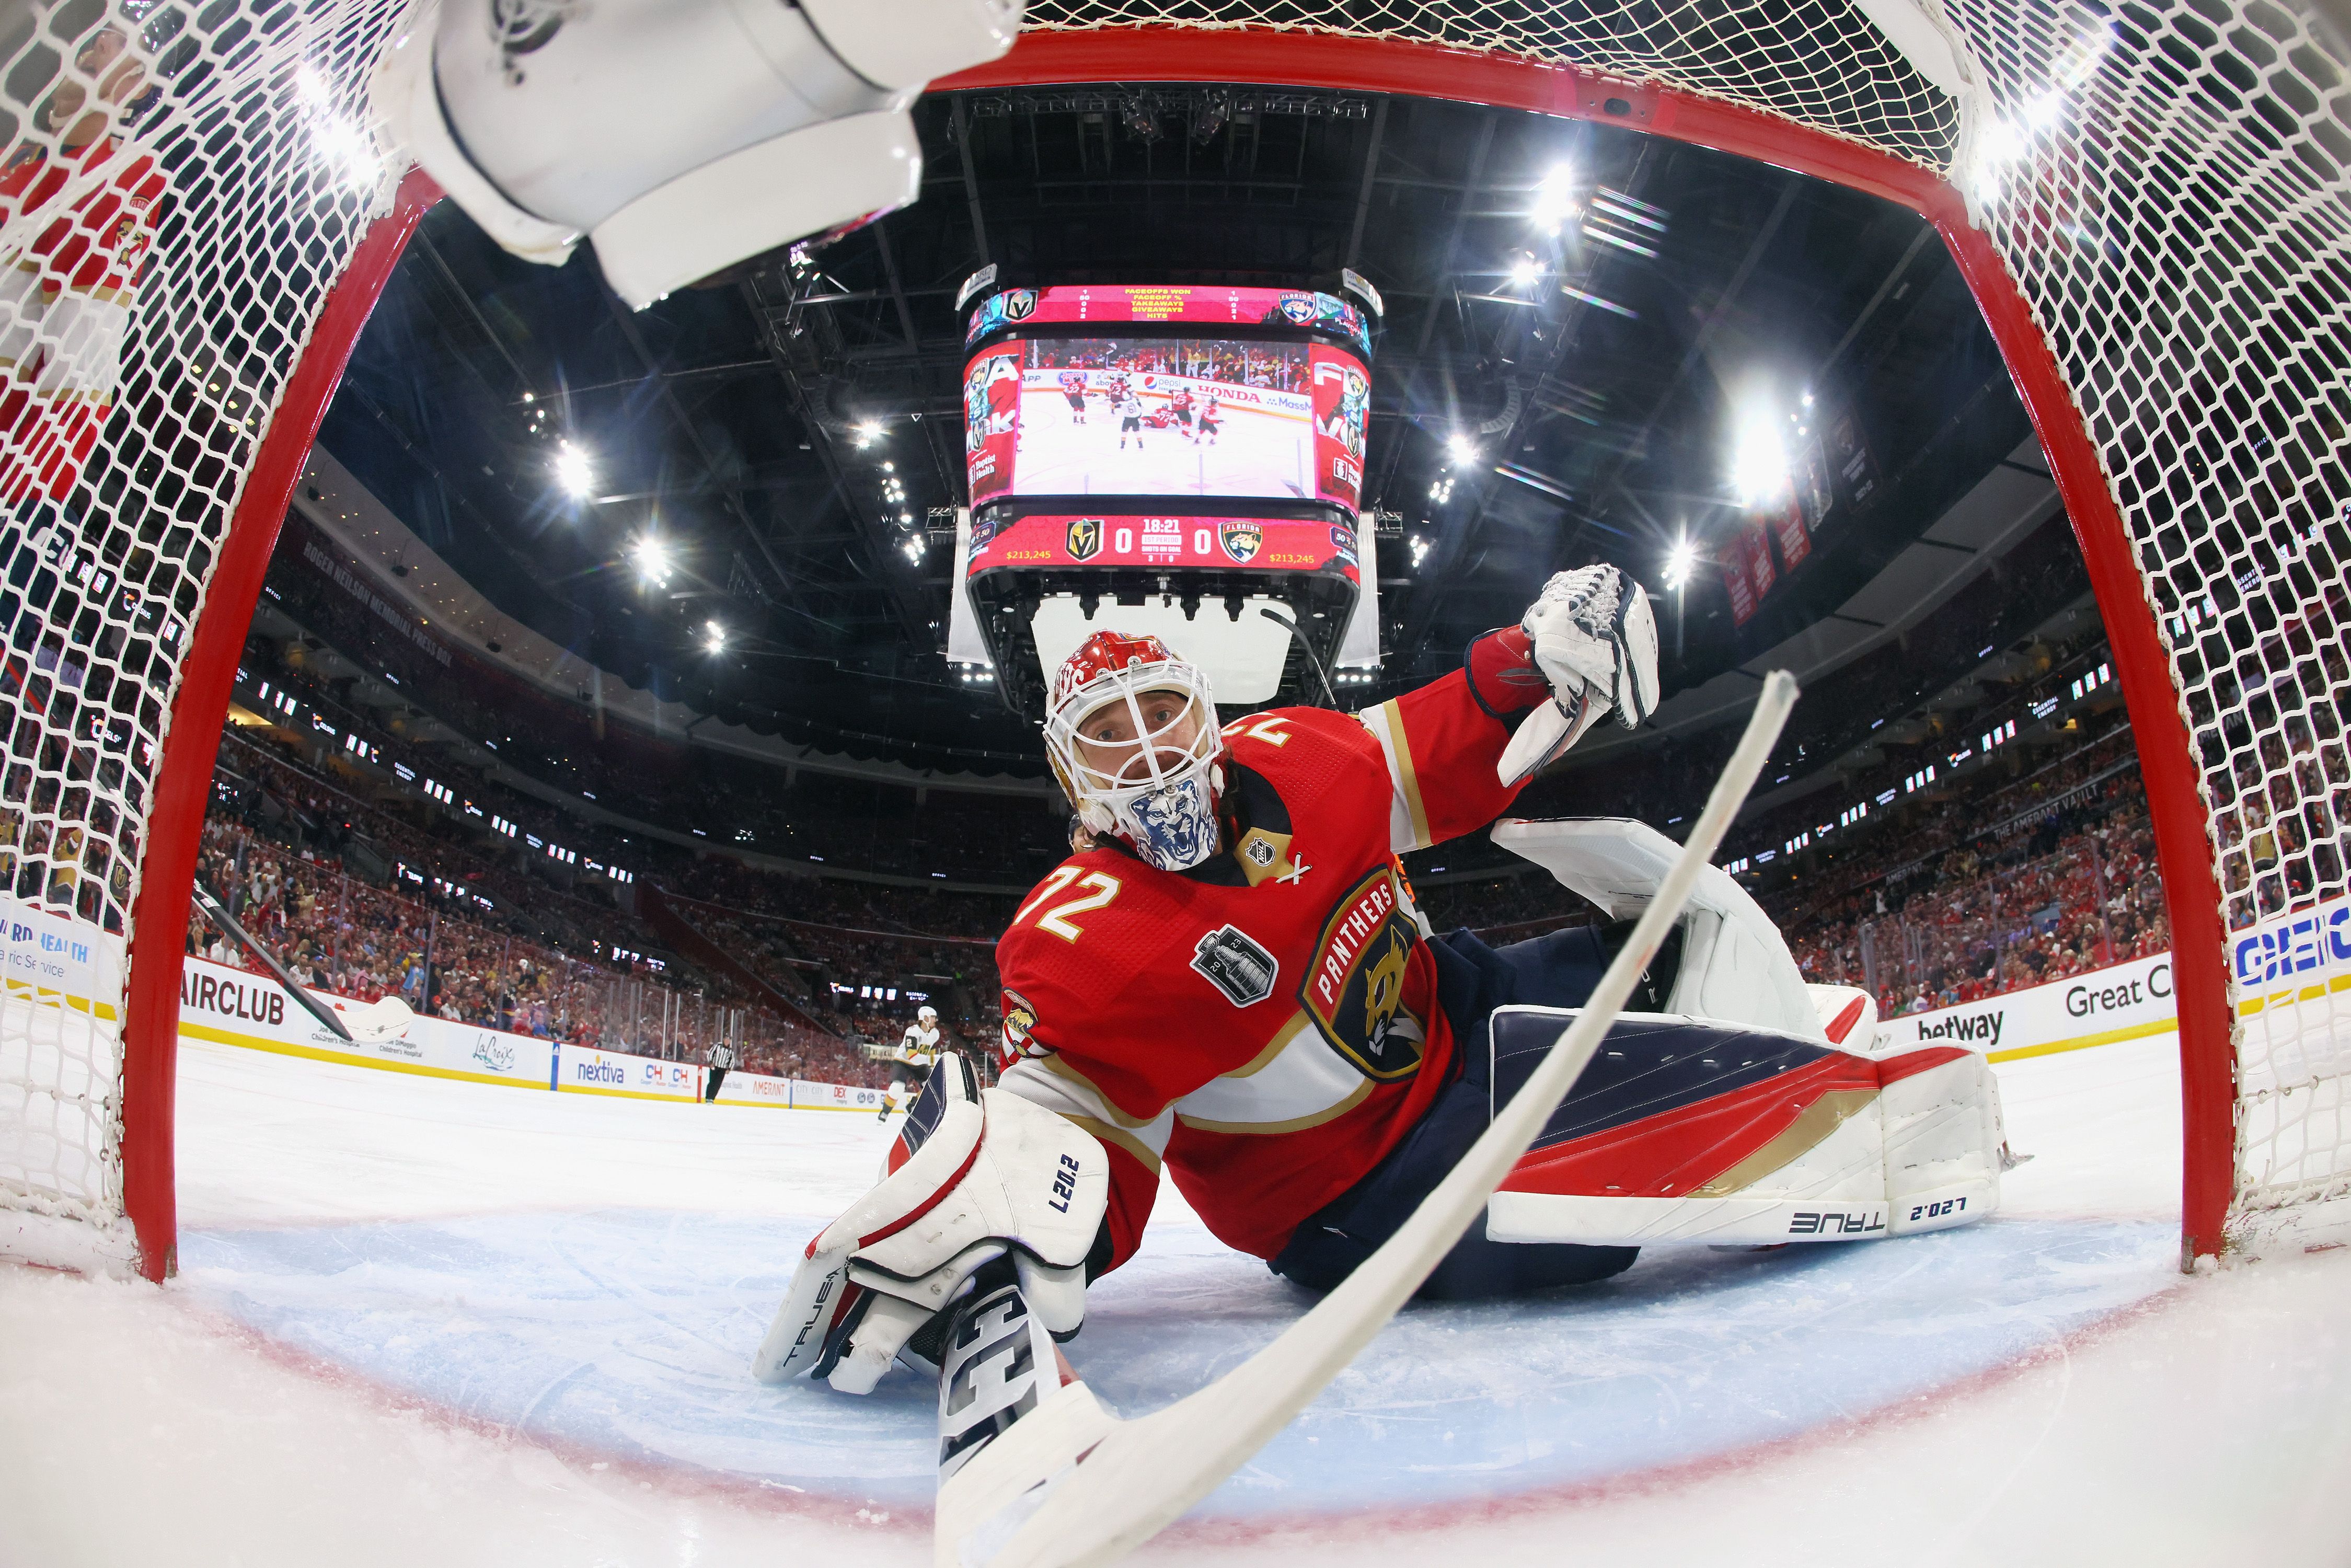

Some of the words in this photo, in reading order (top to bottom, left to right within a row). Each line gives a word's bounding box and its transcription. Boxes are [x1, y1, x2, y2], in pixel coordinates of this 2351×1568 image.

[1158, 378, 1181, 388] pepsi
[1198, 385, 1262, 403] HONDA
[976, 454, 996, 468] Baptist
[976, 466, 995, 480] Health
[1143, 519, 1180, 533] 18:21
[1226, 523, 1260, 532] FLORIDA
[1115, 528, 1132, 554] 0
[1194, 529, 1211, 555] 0
[1006, 550, 1051, 560] $213,245
[1269, 554, 1315, 563] $213,245
[303, 540, 335, 575] ROGER
[333, 564, 371, 606] NEILSON
[1258, 844, 1266, 863] NHL
[1012, 865, 1123, 944] 72
[1230, 938, 1241, 949] 23
[1318, 883, 1392, 1005] PANTHERS
[25, 955, 64, 977] Sevice
[1209, 961, 1221, 973] 20
[2067, 978, 2142, 1017] Great
[312, 1033, 338, 1044] Children's
[395, 1040, 417, 1049] DiMaggio
[379, 1045, 403, 1055] Children's
[578, 1061, 624, 1083] nextiva
[646, 1065, 662, 1080] CH
[673, 1068, 688, 1083] CH
[753, 1080, 785, 1097] AMERANT
[834, 1087, 846, 1098] DEX
[1048, 1154, 1079, 1214] L20.2
[1910, 1197, 1966, 1221] L20.2
[1789, 1211, 1885, 1233] TRUE
[783, 1281, 834, 1368] TRUE
